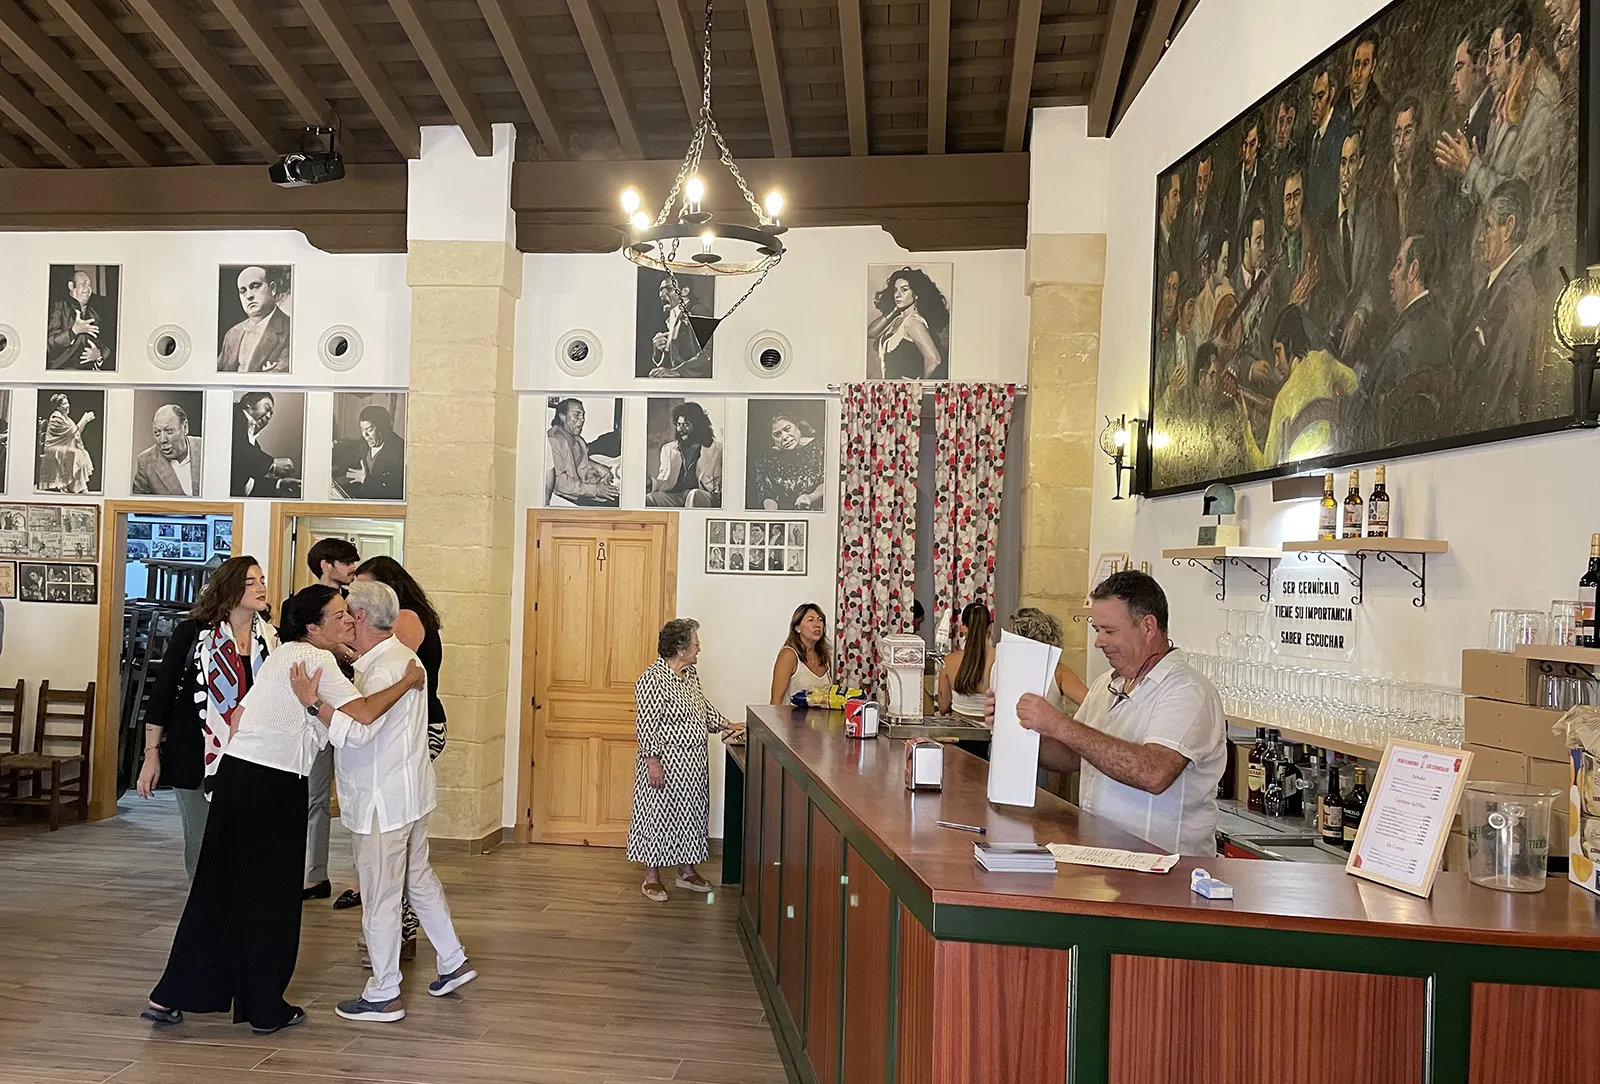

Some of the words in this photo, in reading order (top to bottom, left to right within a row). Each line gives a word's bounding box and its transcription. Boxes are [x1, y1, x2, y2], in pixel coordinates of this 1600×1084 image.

[1282, 581, 1296, 594] SER
[1298, 578, 1339, 595] CERNÍCALO
[1275, 605, 1293, 618] TIENE
[1295, 606, 1304, 619] SU
[1305, 607, 1352, 621] IMPORTANCIA
[1281, 631, 1302, 645] SABER
[1305, 633, 1344, 649] ESCUCHAR
